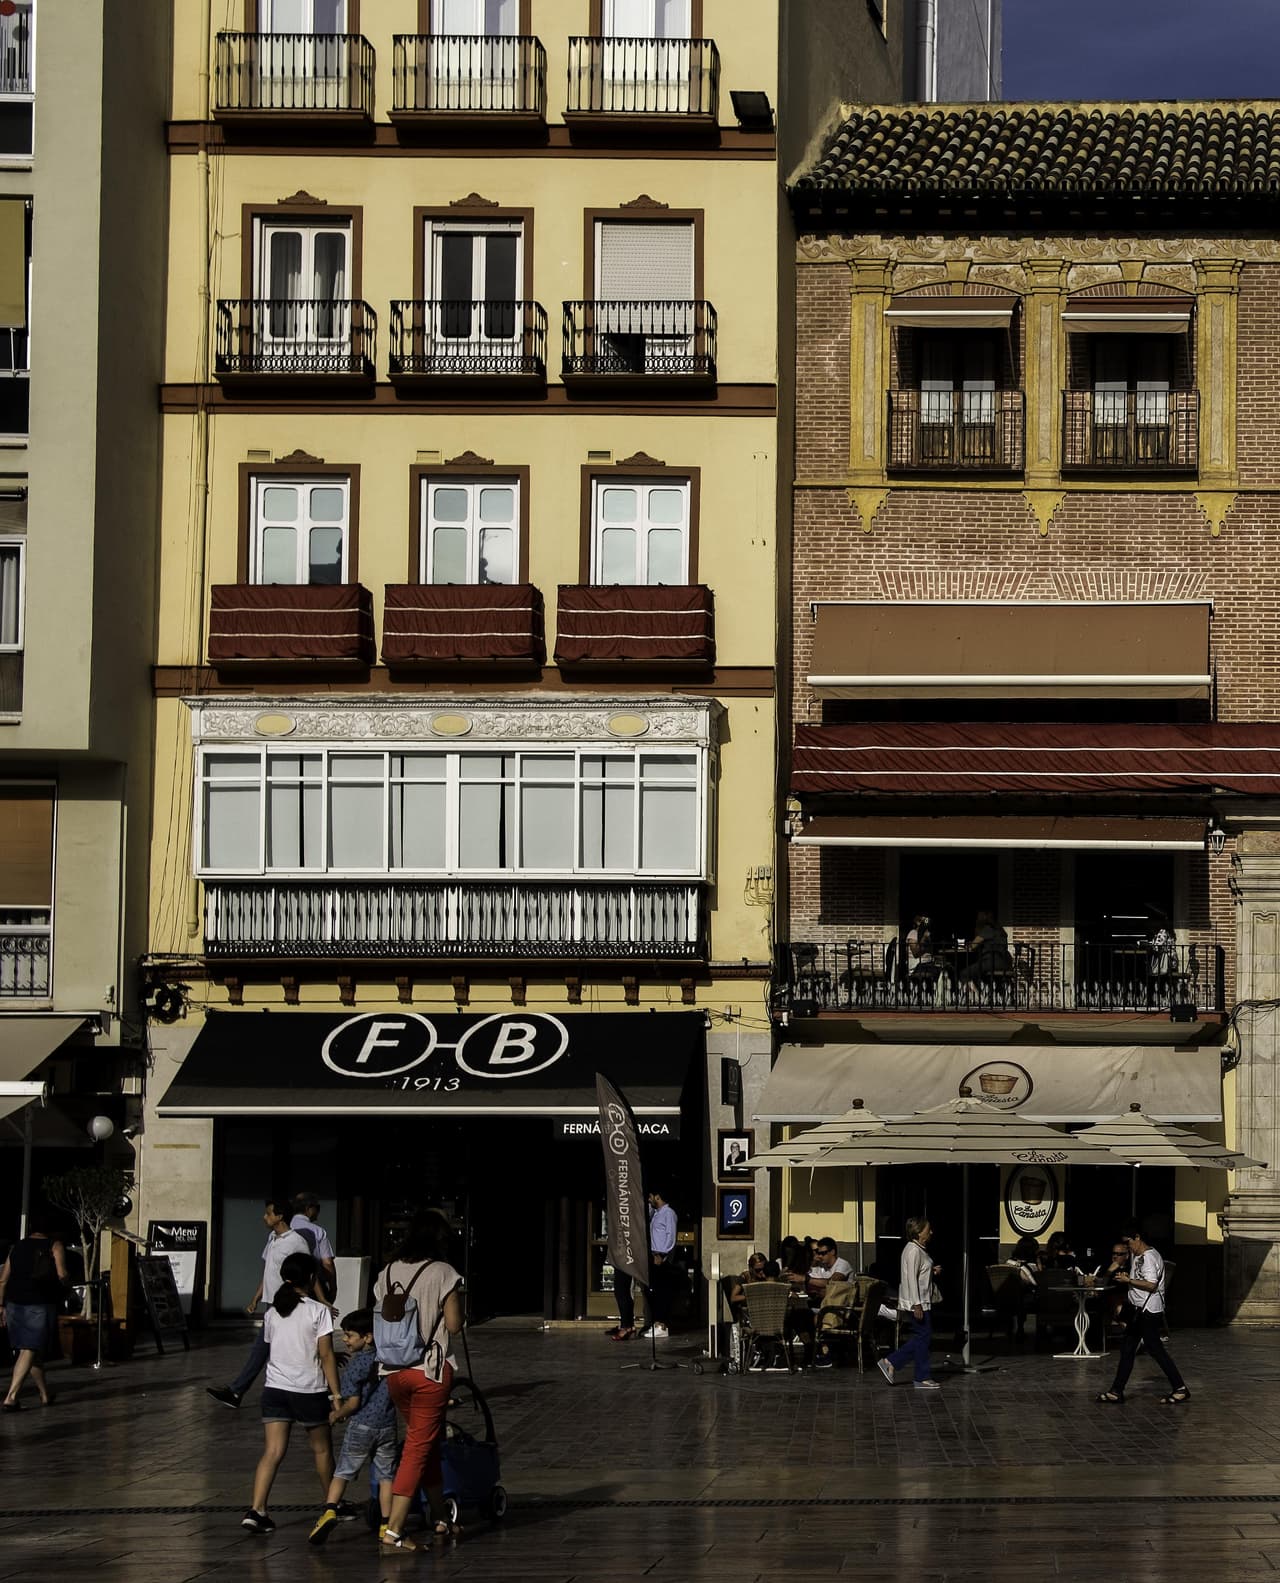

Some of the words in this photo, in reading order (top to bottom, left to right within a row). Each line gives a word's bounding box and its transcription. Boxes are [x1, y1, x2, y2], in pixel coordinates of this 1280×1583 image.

[355, 1021, 407, 1064] F
[488, 1021, 538, 1065] B
[400, 1076, 461, 1091] 1913
